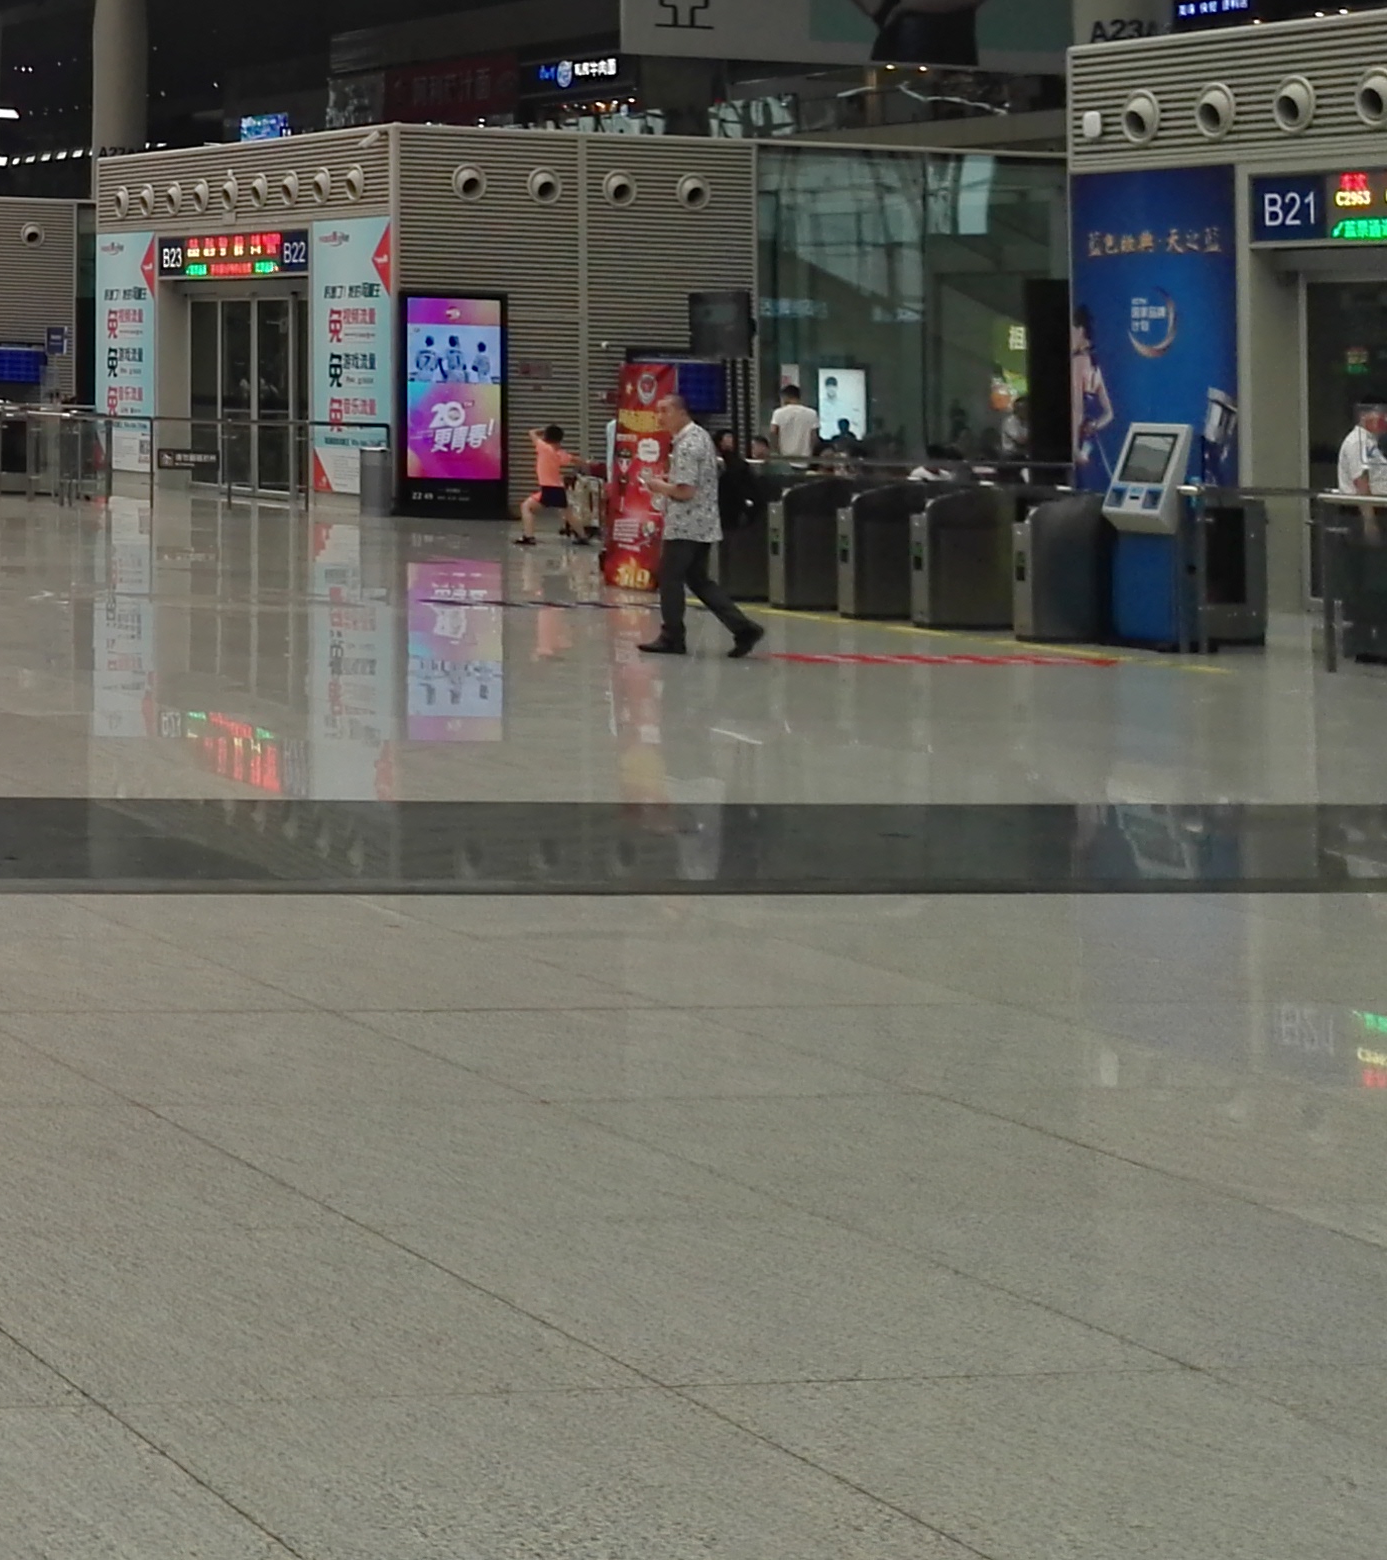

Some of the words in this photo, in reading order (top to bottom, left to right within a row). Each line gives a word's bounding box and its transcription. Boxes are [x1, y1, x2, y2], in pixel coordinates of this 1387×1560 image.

[1264, 191, 1315, 226] B21
[163, 247, 182, 267] B23
[284, 241, 305, 262] B22
[329, 307, 342, 342] 免
[329, 352, 342, 387] 免
